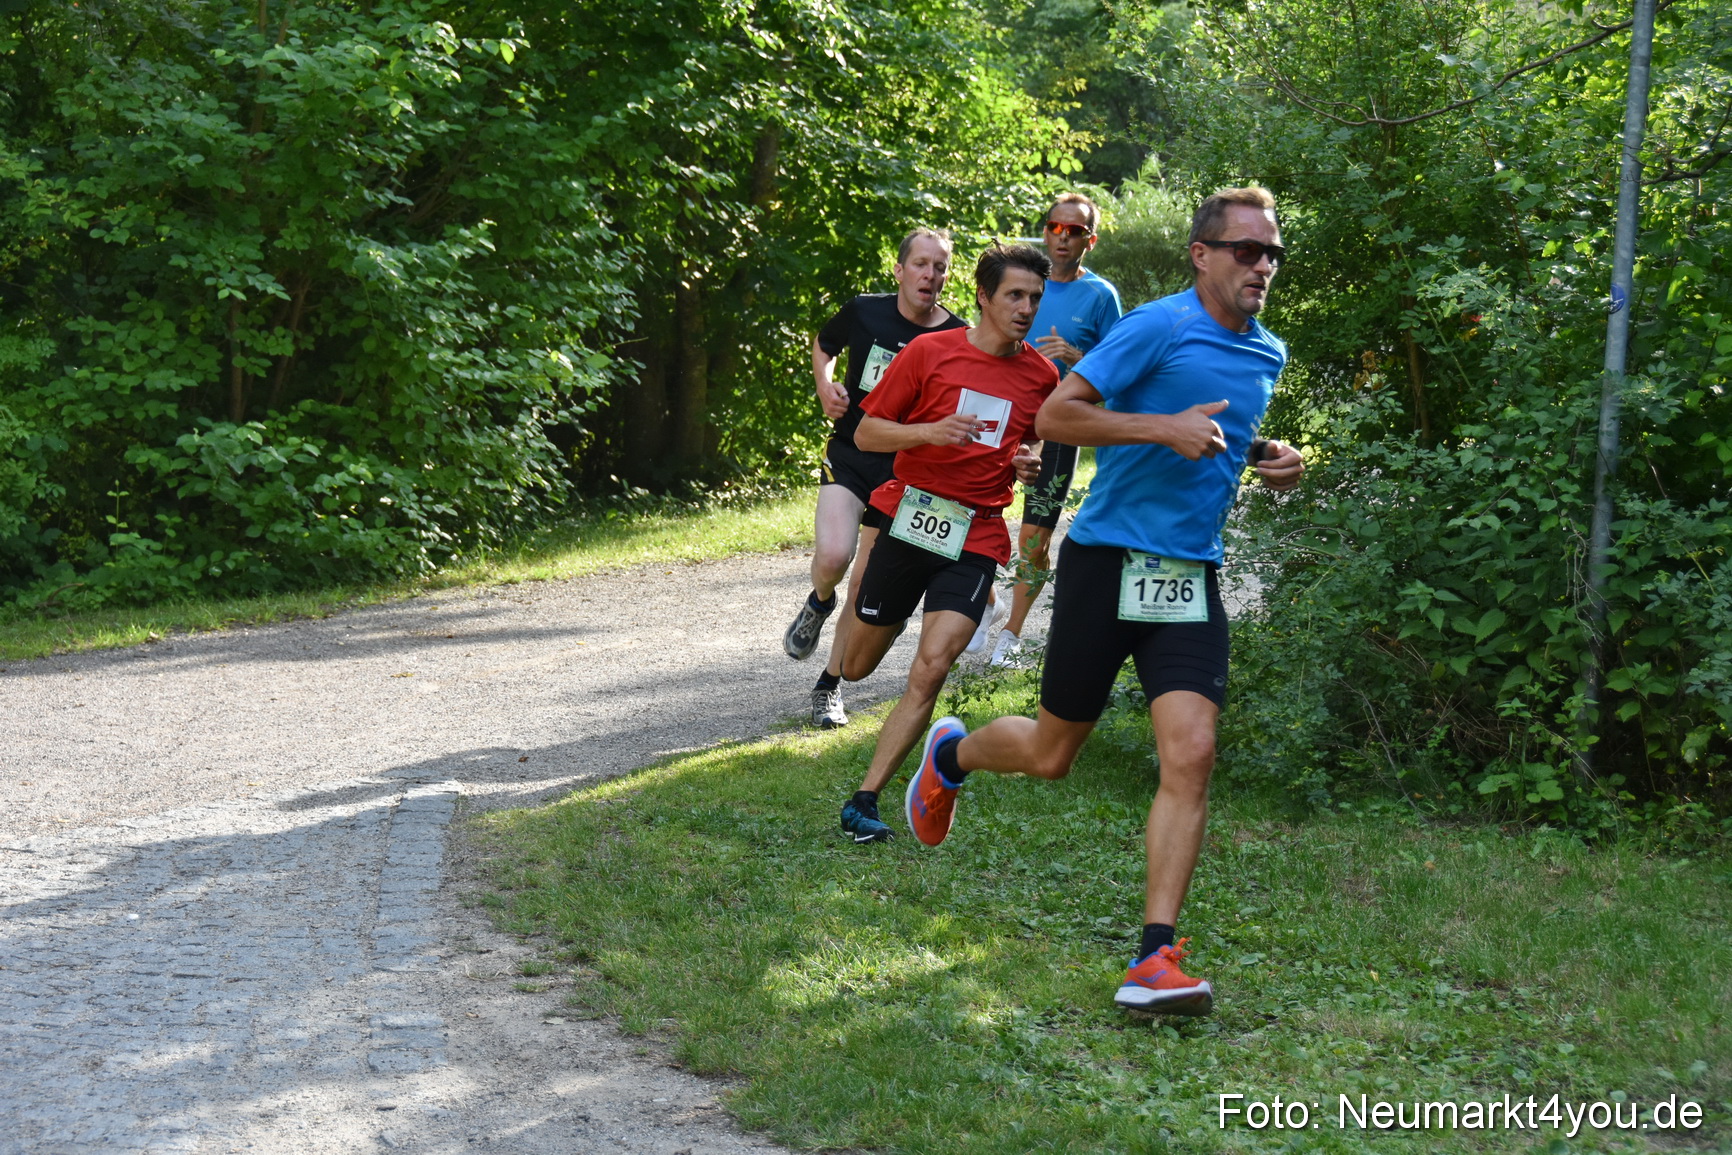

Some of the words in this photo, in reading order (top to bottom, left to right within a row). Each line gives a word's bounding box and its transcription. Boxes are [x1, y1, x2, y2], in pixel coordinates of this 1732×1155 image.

[872, 364, 887, 381] 1
[910, 510, 951, 539] 509
[930, 536, 948, 547] Stefan
[1134, 578, 1194, 603] 1736
